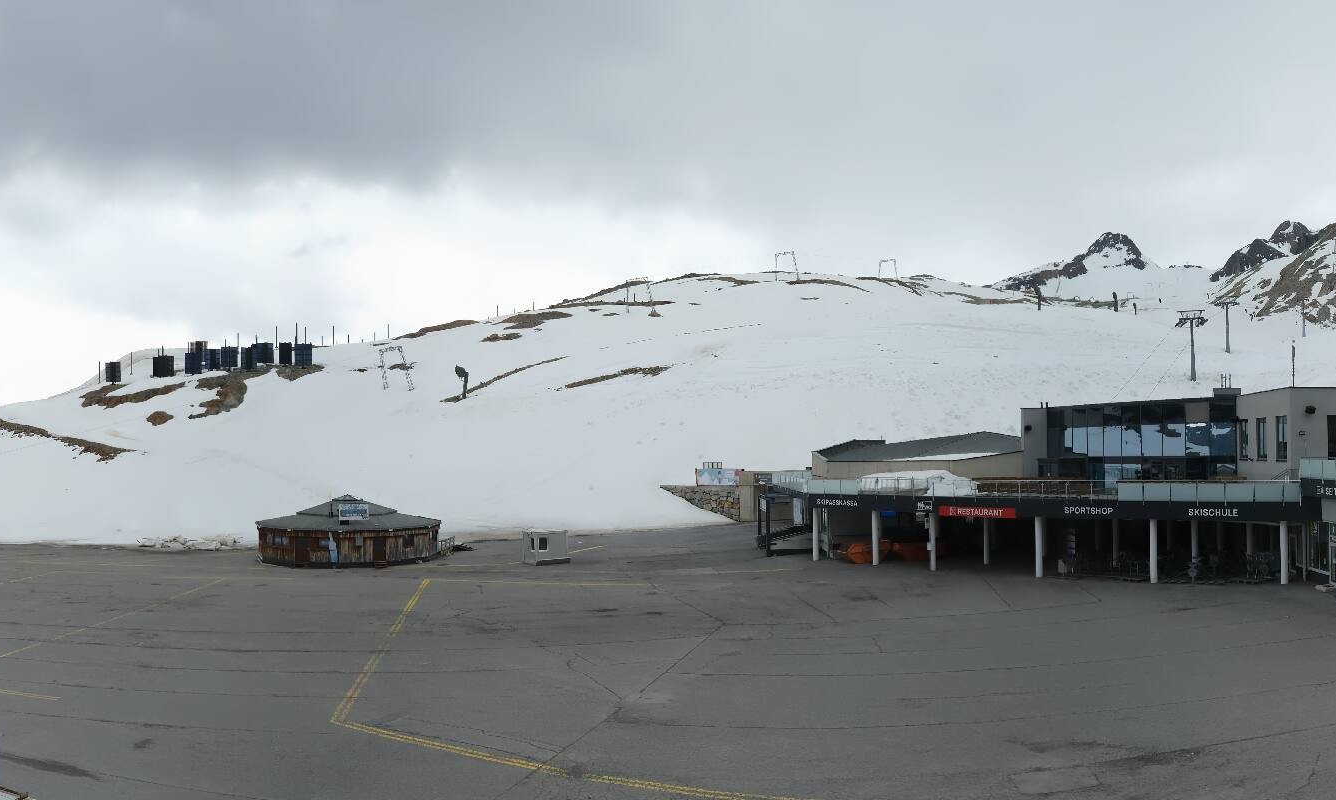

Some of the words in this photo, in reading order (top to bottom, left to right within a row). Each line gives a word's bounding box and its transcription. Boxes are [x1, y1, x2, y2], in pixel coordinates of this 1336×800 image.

[957, 508, 1004, 517] RESTAURANT
[1064, 506, 1114, 515] SPORTSHOP
[1188, 508, 1239, 517] SKISCHULE
